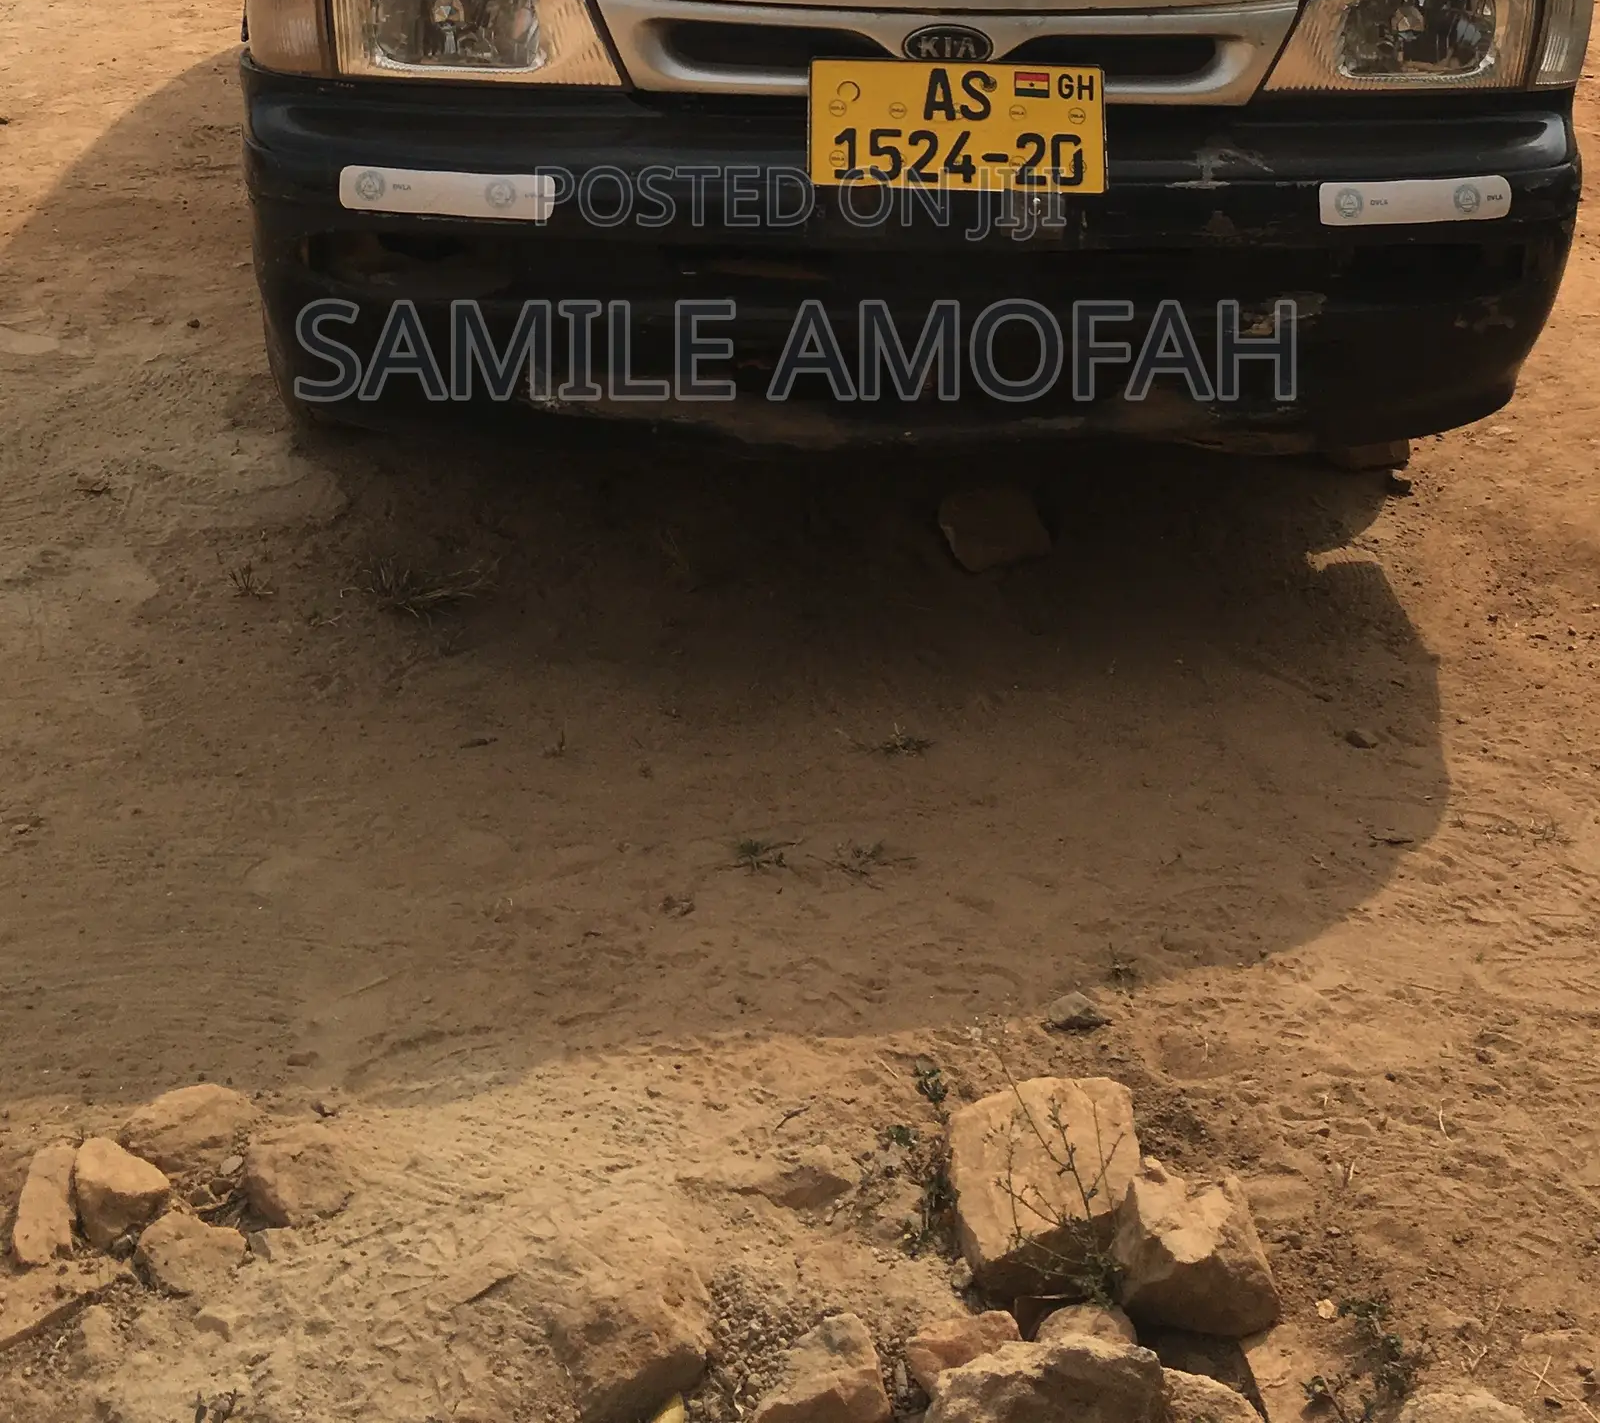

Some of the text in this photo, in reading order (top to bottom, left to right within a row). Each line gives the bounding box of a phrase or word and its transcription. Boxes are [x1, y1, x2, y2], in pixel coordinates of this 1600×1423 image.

[919, 36, 977, 59] KIA
[923, 67, 1094, 122] AS GH
[833, 127, 1084, 186] 1524-20
